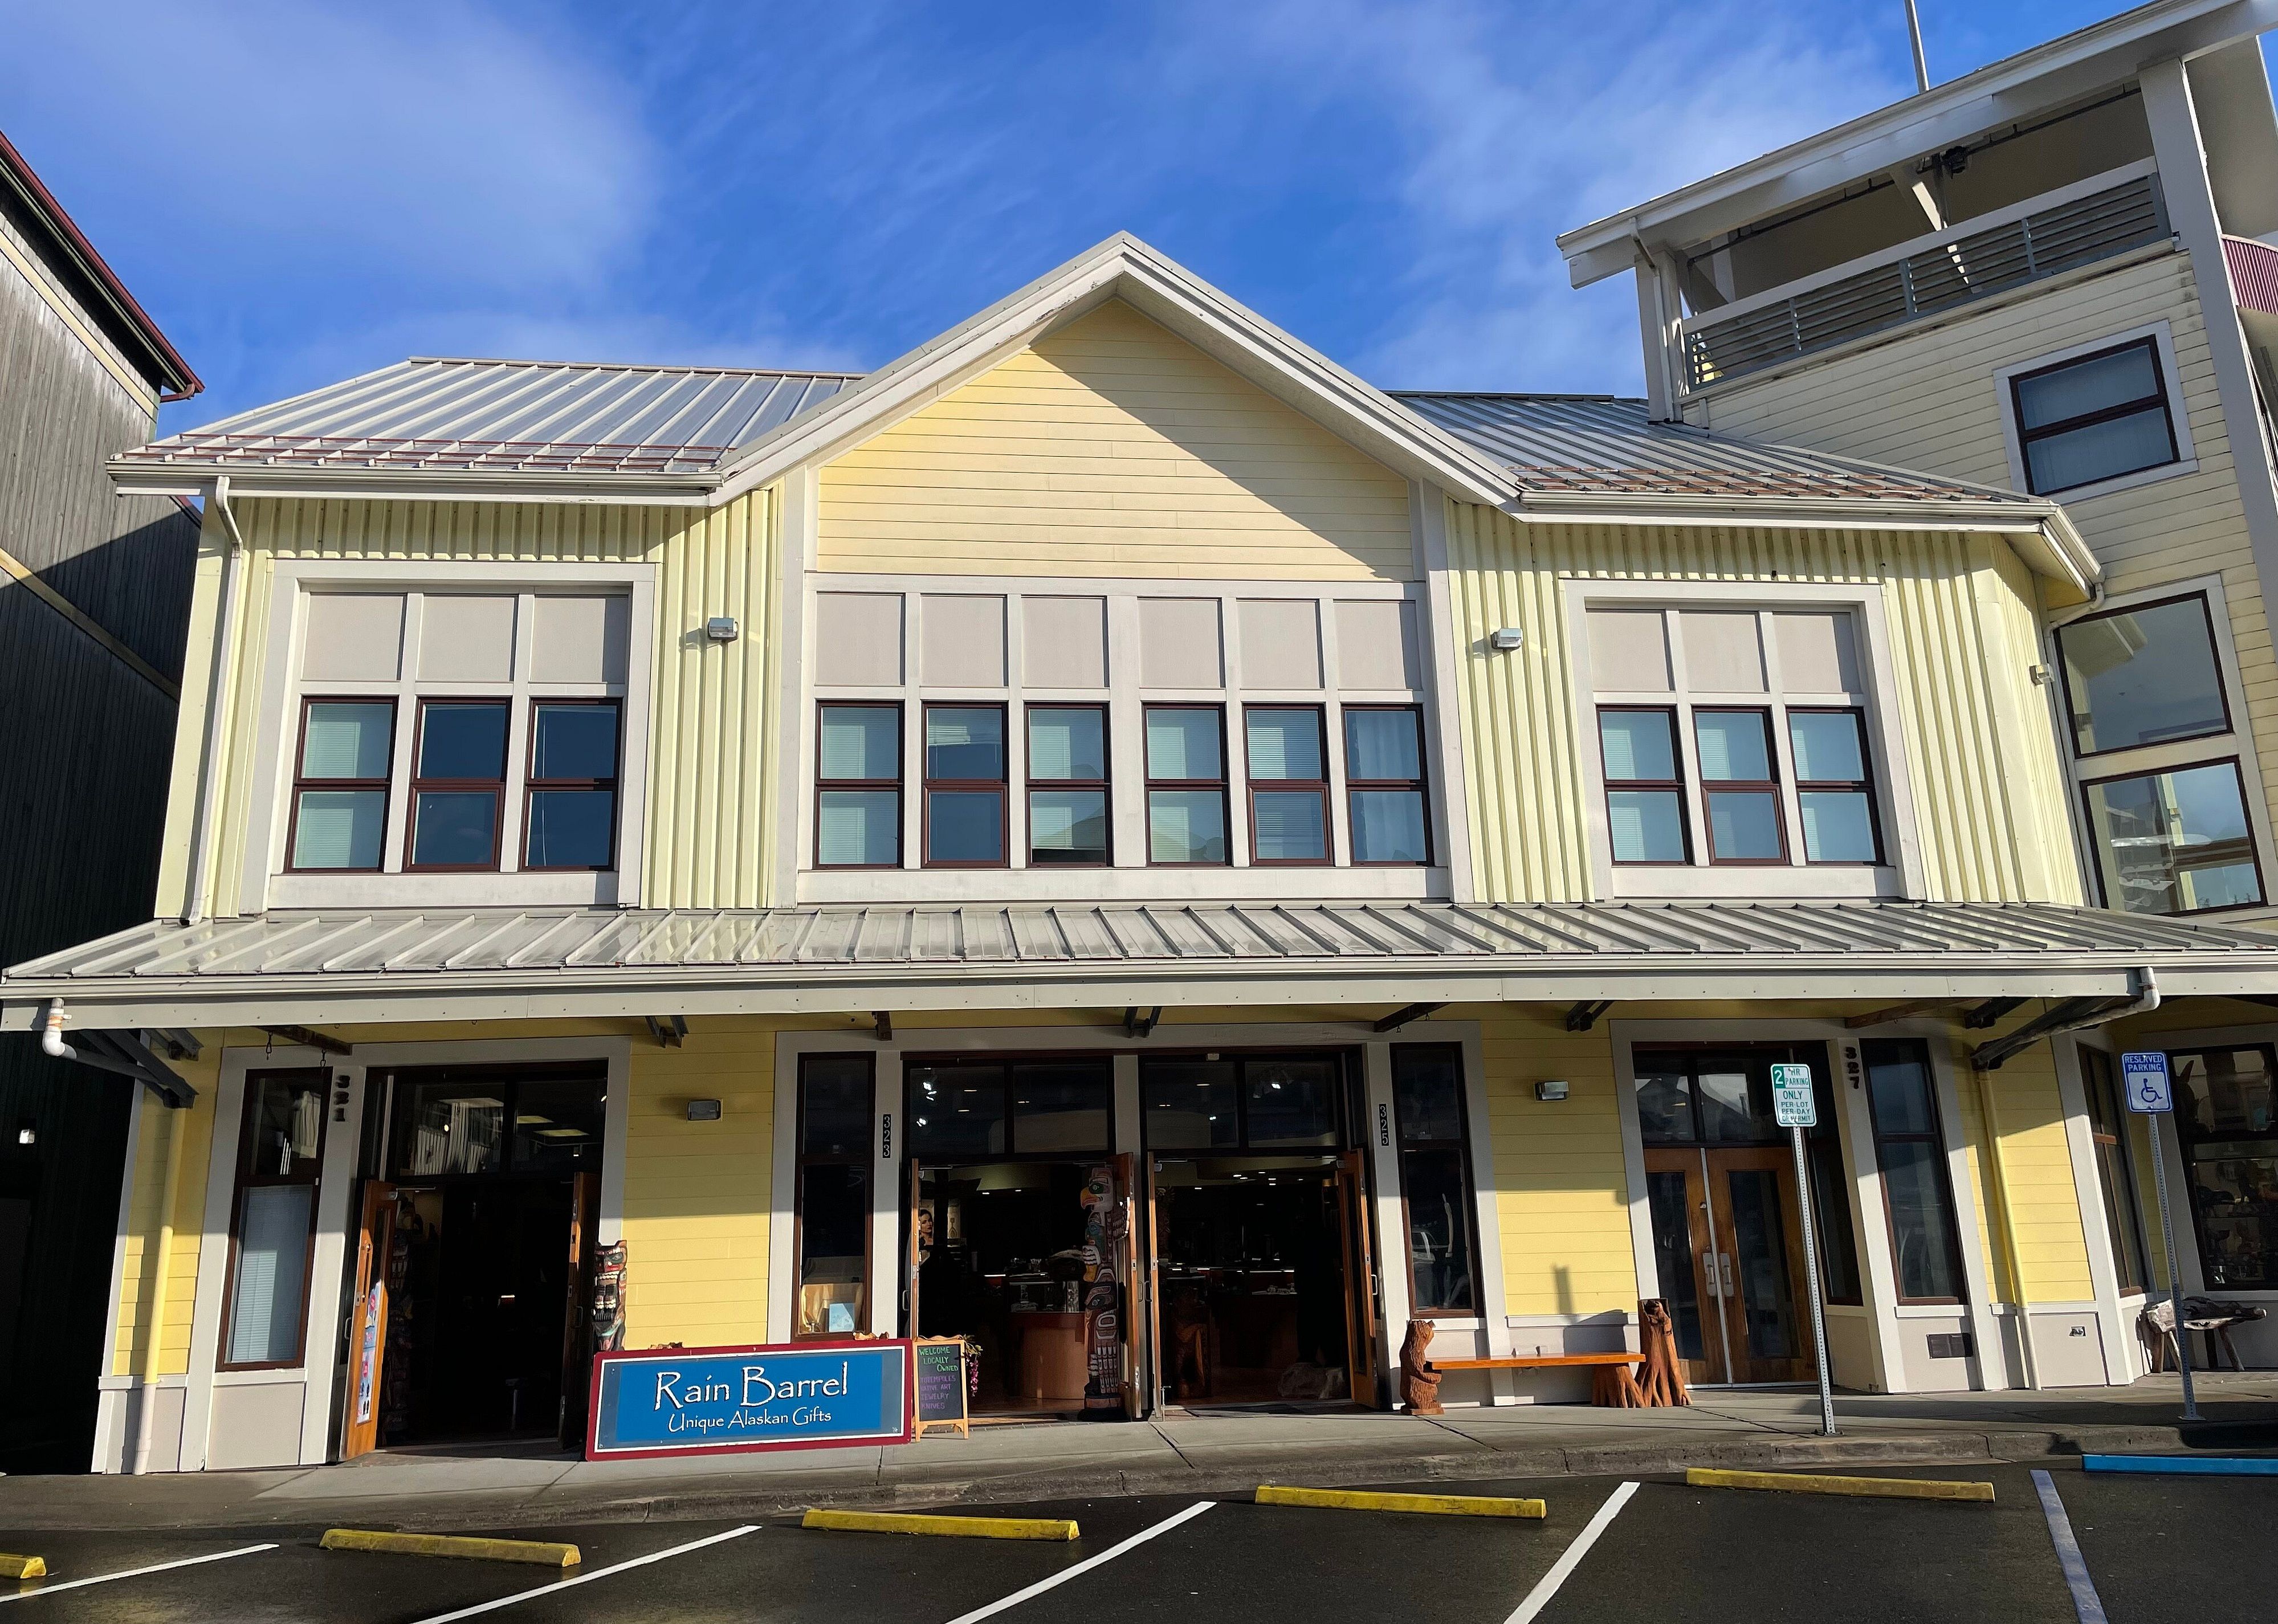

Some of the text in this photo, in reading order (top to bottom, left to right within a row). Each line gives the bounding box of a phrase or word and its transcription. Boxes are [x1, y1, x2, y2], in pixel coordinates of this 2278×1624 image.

[1774, 1070, 1783, 1084] 2
[1845, 1047, 1859, 1090] 327
[1783, 1091, 1803, 1100] ONLY
[1380, 1105, 1388, 1145] 325
[919, 1346, 951, 1356] WELCOME
[654, 1361, 848, 1411] Rain Barrel
[668, 1406, 832, 1434] Unique Alaskan Gifts
